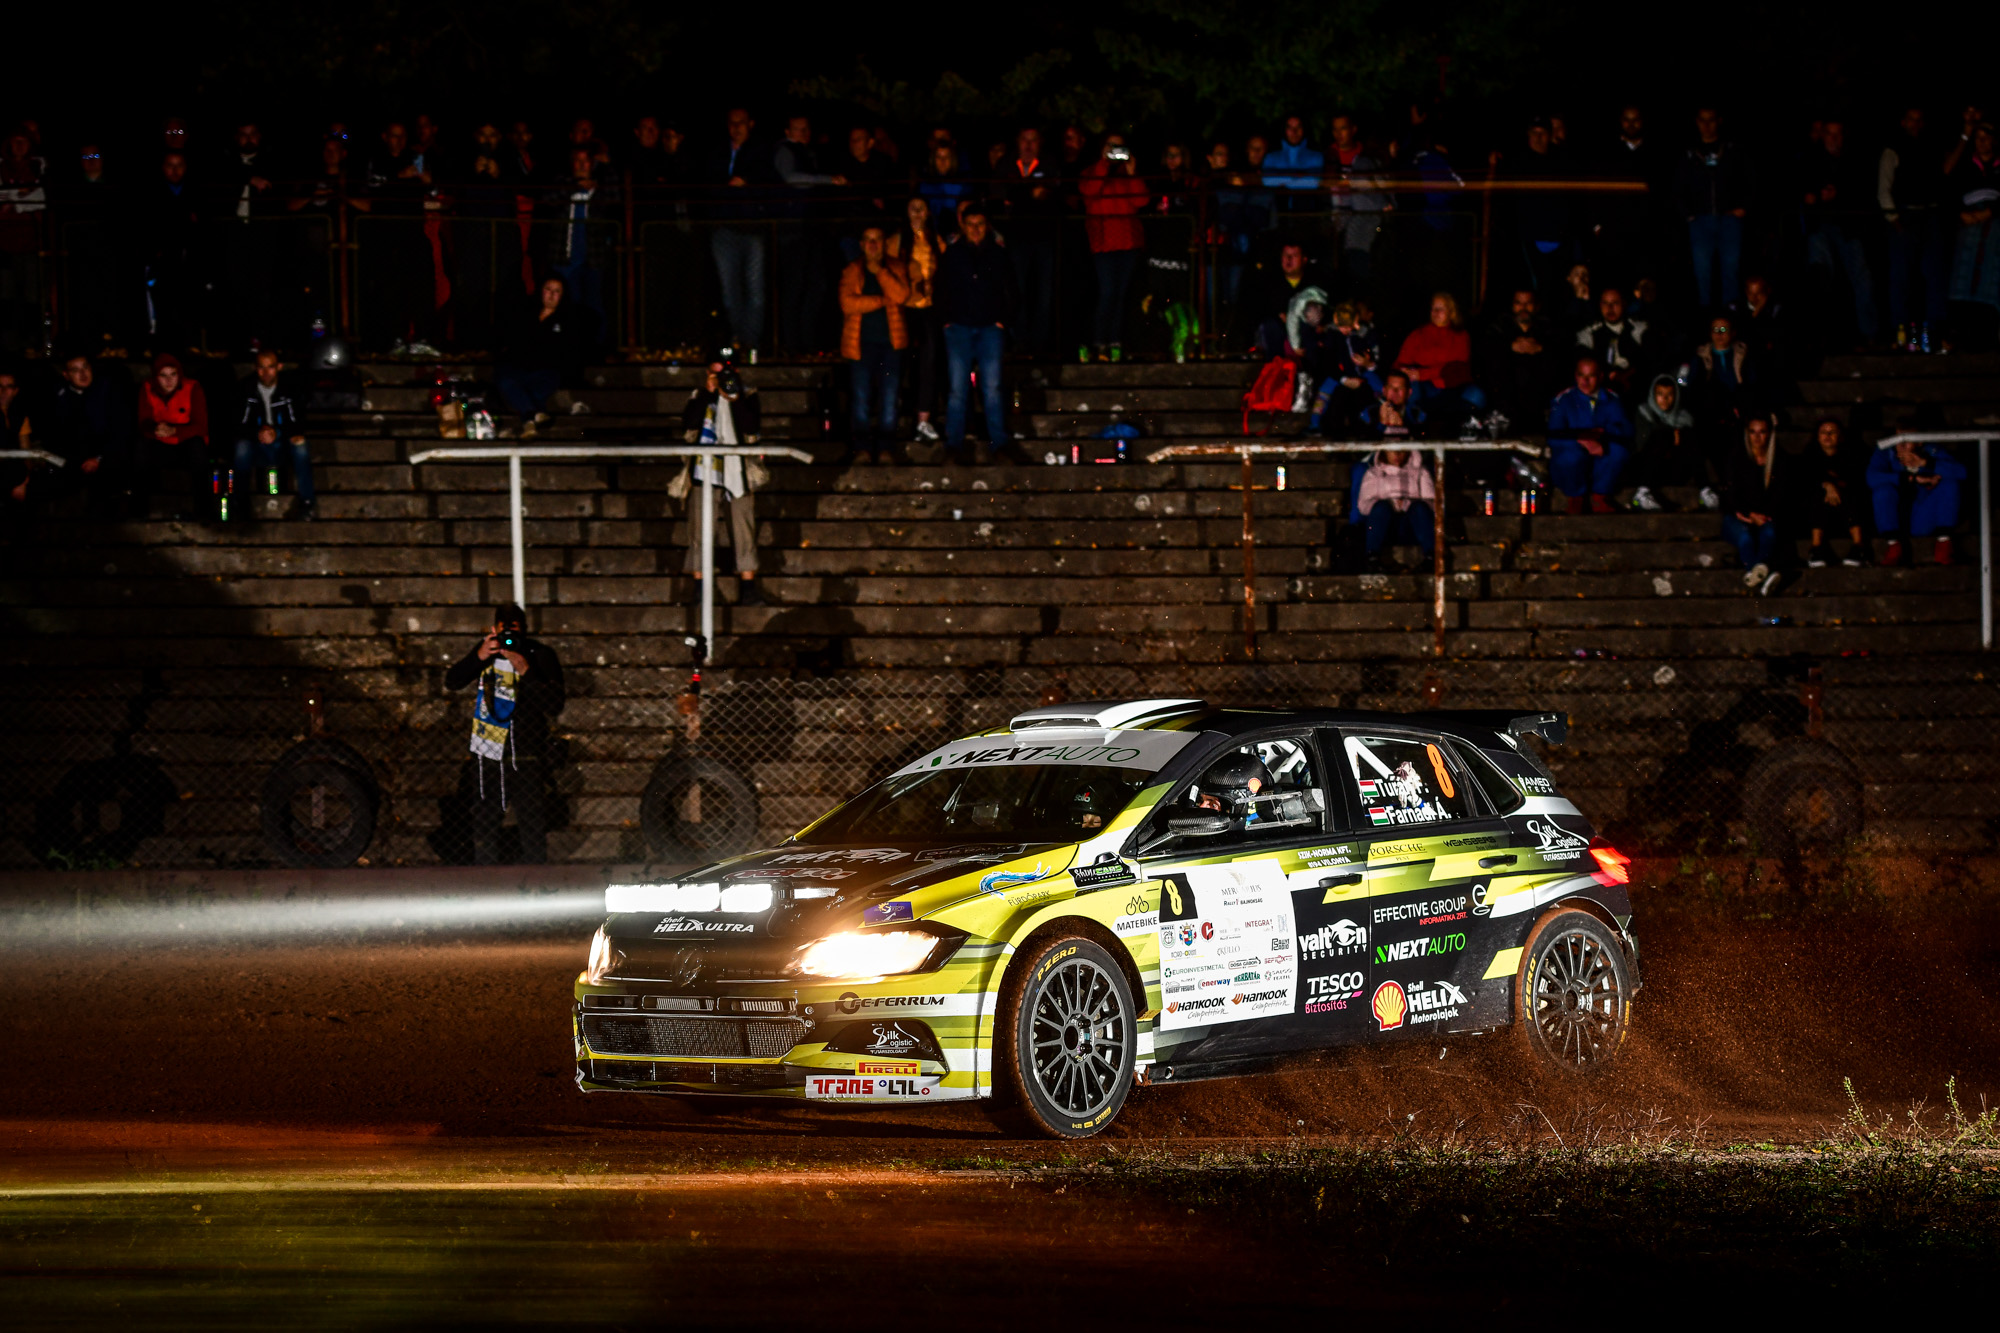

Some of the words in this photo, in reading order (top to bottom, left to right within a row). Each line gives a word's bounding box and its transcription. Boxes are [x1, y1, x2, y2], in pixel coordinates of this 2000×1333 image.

[950, 745, 1141, 766] NEXTAUTO
[1426, 743, 1455, 799] 8
[1443, 836, 1496, 847] WEINSBERG
[1370, 843, 1425, 856] PORSCHE
[1165, 879, 1182, 915] 8
[1374, 901, 1429, 923] EFFECTIVE
[1430, 896, 1467, 914] GROUP
[653, 919, 704, 933] HELIX
[704, 922, 754, 932] ULTRA
[661, 916, 685, 924] Shell
[1116, 916, 1158, 932] MATEBIKE
[1419, 914, 1456, 926] INFORMATIKA
[1303, 944, 1367, 961] SECURITY
[1387, 932, 1466, 962] NEXTAUTO
[1172, 964, 1225, 976] EUROINVESTMETAL
[1201, 978, 1231, 987] enerway
[1307, 972, 1364, 995] TESCO
[1407, 982, 1424, 992] Shell
[1407, 981, 1468, 1012] HELIX
[1305, 1000, 1347, 1014] Biztosítás
[1410, 1009, 1459, 1025] Motorolajok
[859, 1062, 917, 1074] PIRELLI
